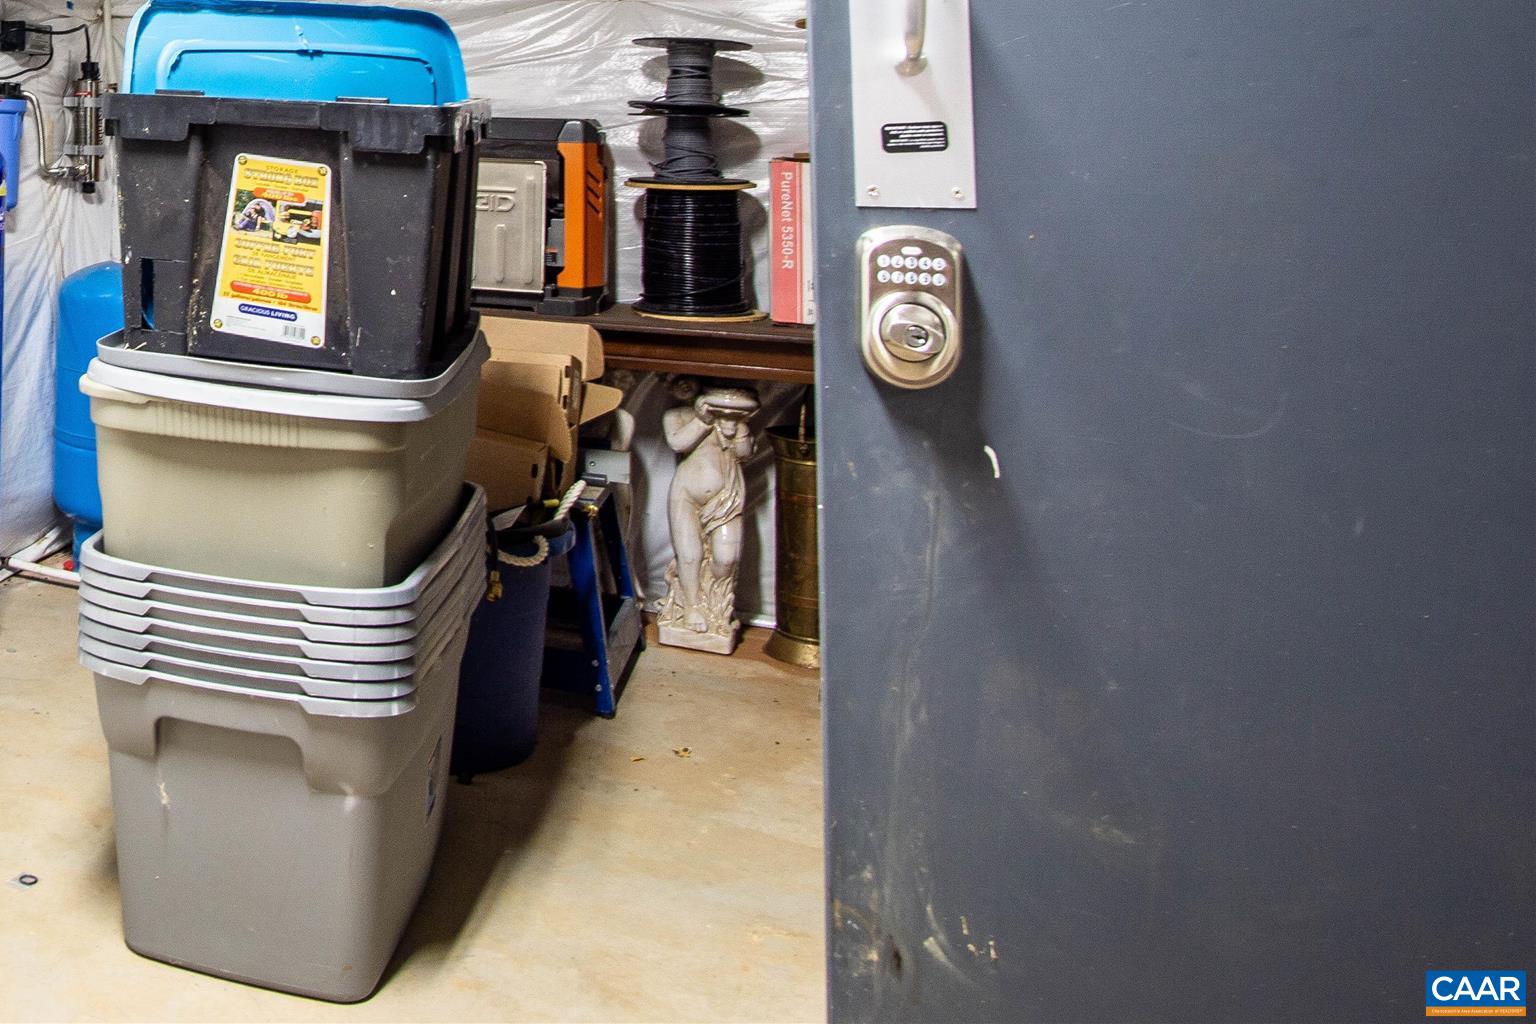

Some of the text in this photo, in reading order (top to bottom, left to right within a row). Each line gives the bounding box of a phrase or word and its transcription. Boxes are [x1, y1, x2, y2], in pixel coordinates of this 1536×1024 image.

[780, 171, 794, 222] PureNet
[240, 305, 296, 320] GRACIOUS LIVING
